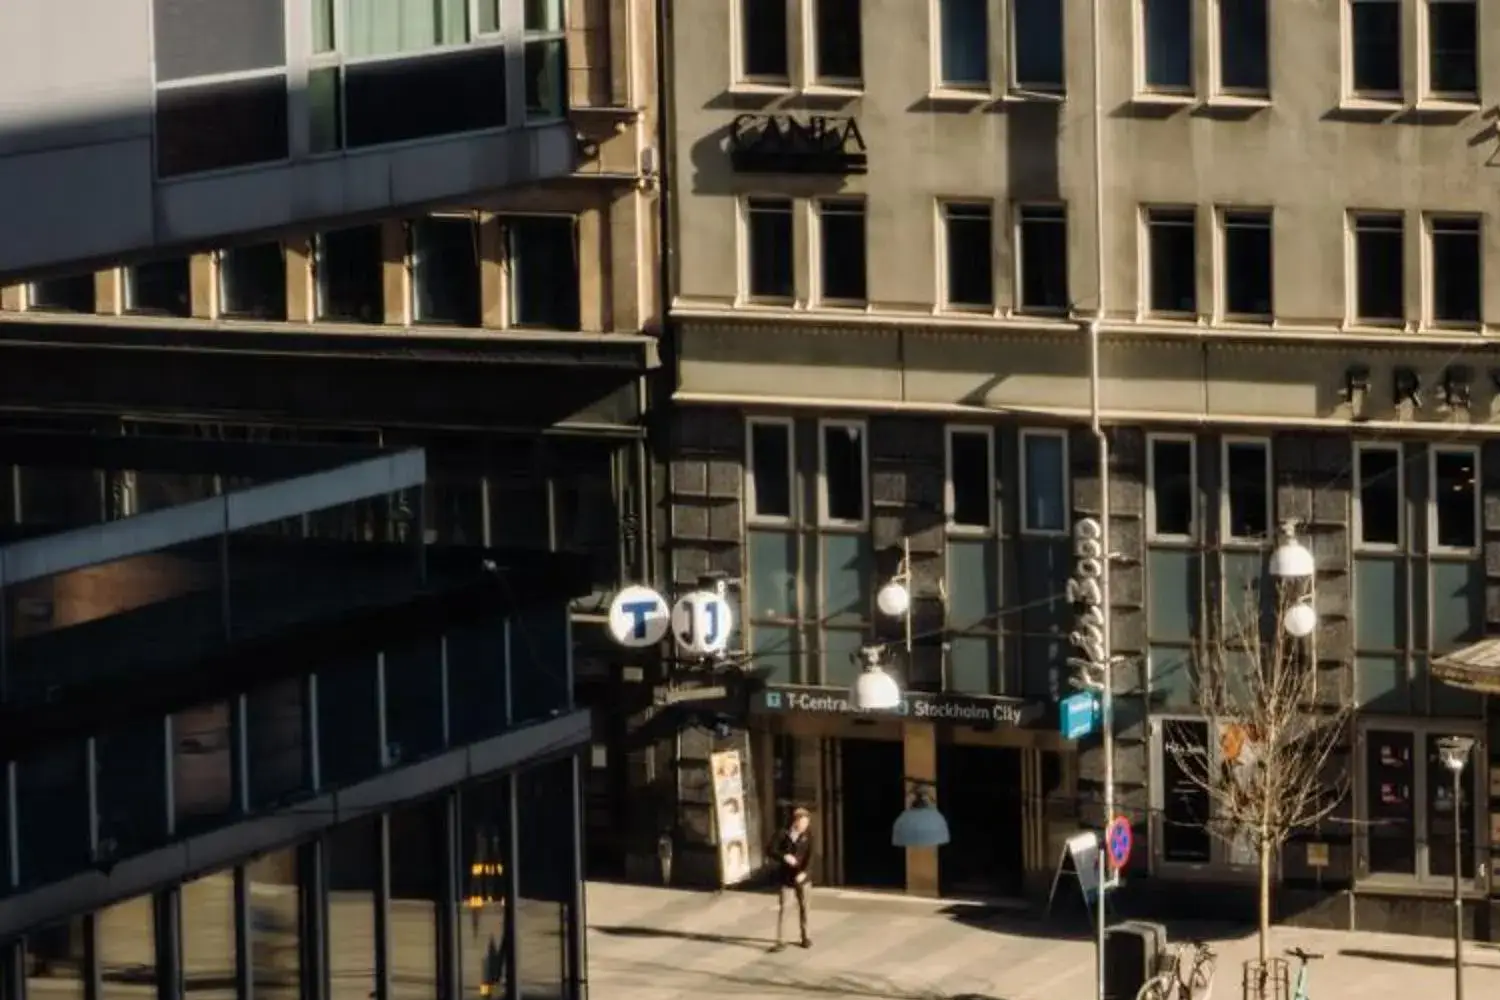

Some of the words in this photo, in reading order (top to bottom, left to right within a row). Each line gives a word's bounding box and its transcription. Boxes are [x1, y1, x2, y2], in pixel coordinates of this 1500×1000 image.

[621, 601, 658, 639] T
[786, 691, 872, 712] T-Centra
[915, 700, 990, 719] Stockholm
[993, 704, 1021, 726] City
